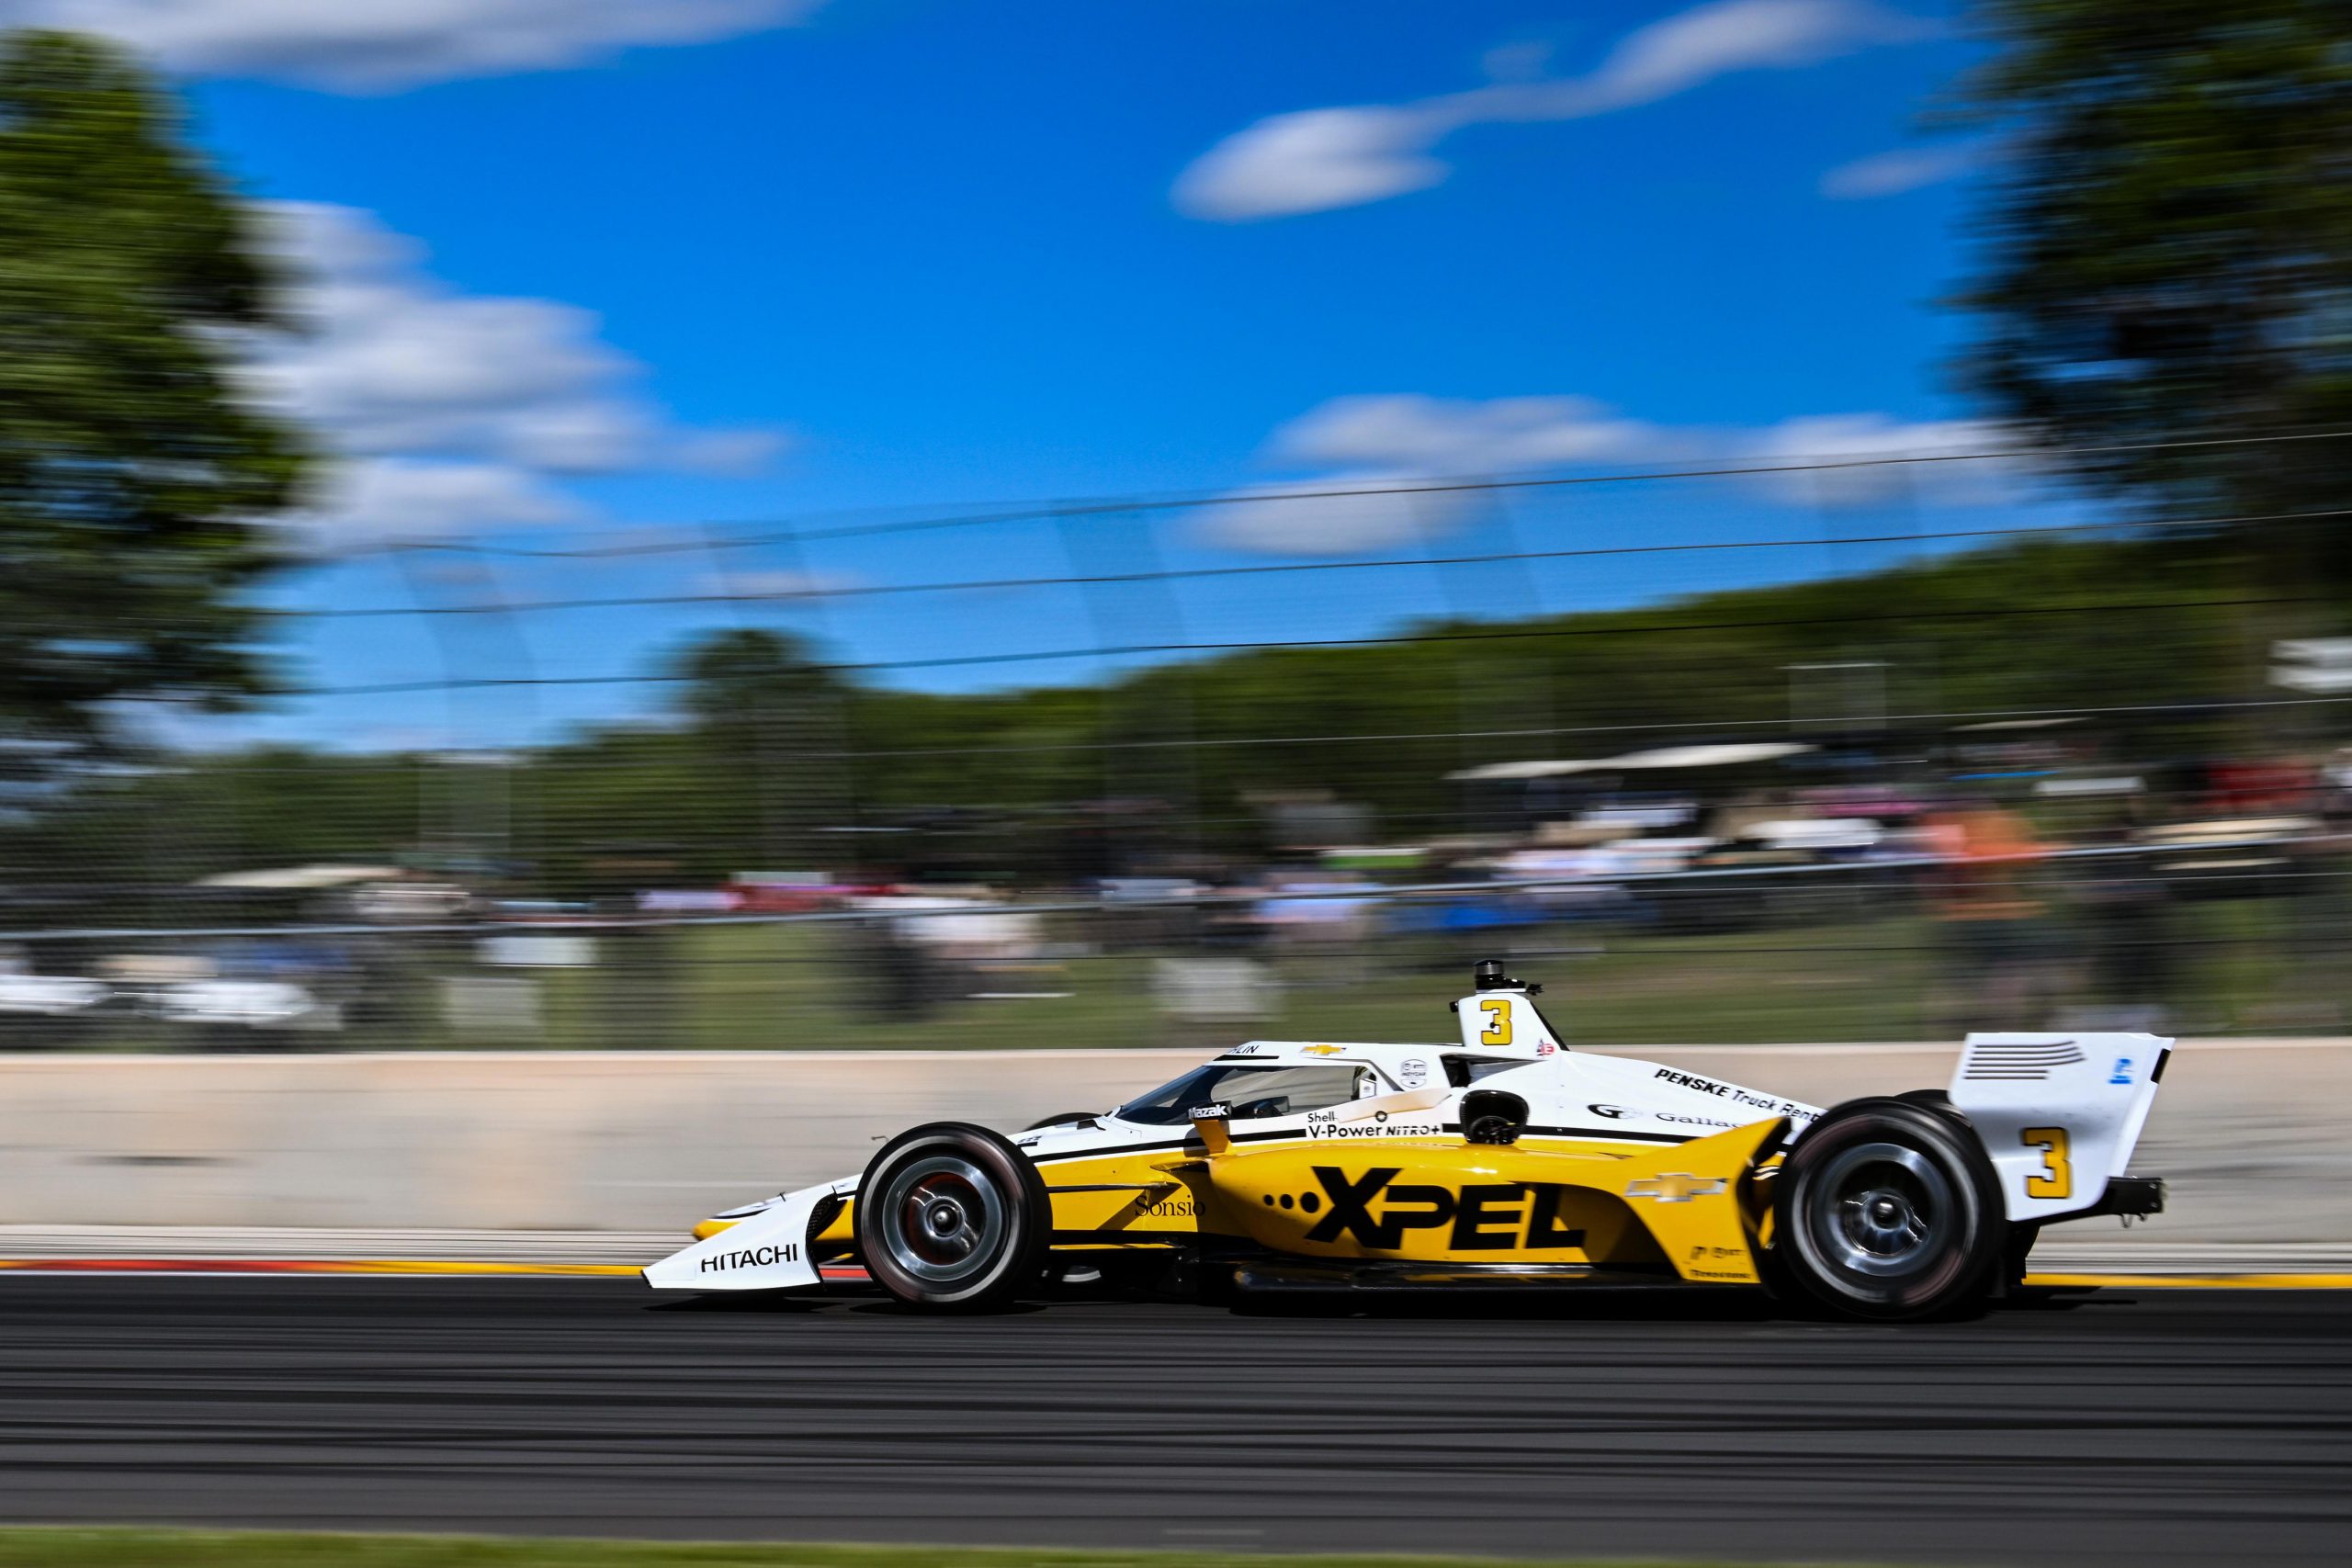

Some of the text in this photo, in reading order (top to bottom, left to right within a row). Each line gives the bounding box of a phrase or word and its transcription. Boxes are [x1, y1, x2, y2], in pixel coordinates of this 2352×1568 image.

[1480, 999, 1512, 1045] 3
[1654, 1068, 1731, 1097] PENSKE
[1732, 1089, 1778, 1111] Truck
[1188, 1104, 1228, 1120] Mazak
[1307, 1111, 1335, 1122] Shell
[1308, 1124, 1383, 1138] V-Power
[2020, 1126, 2073, 1199] 3
[1135, 1194, 1206, 1217] Sonsio
[1304, 1166, 1587, 1251] XPEL
[700, 1243, 798, 1273] HITACHI
